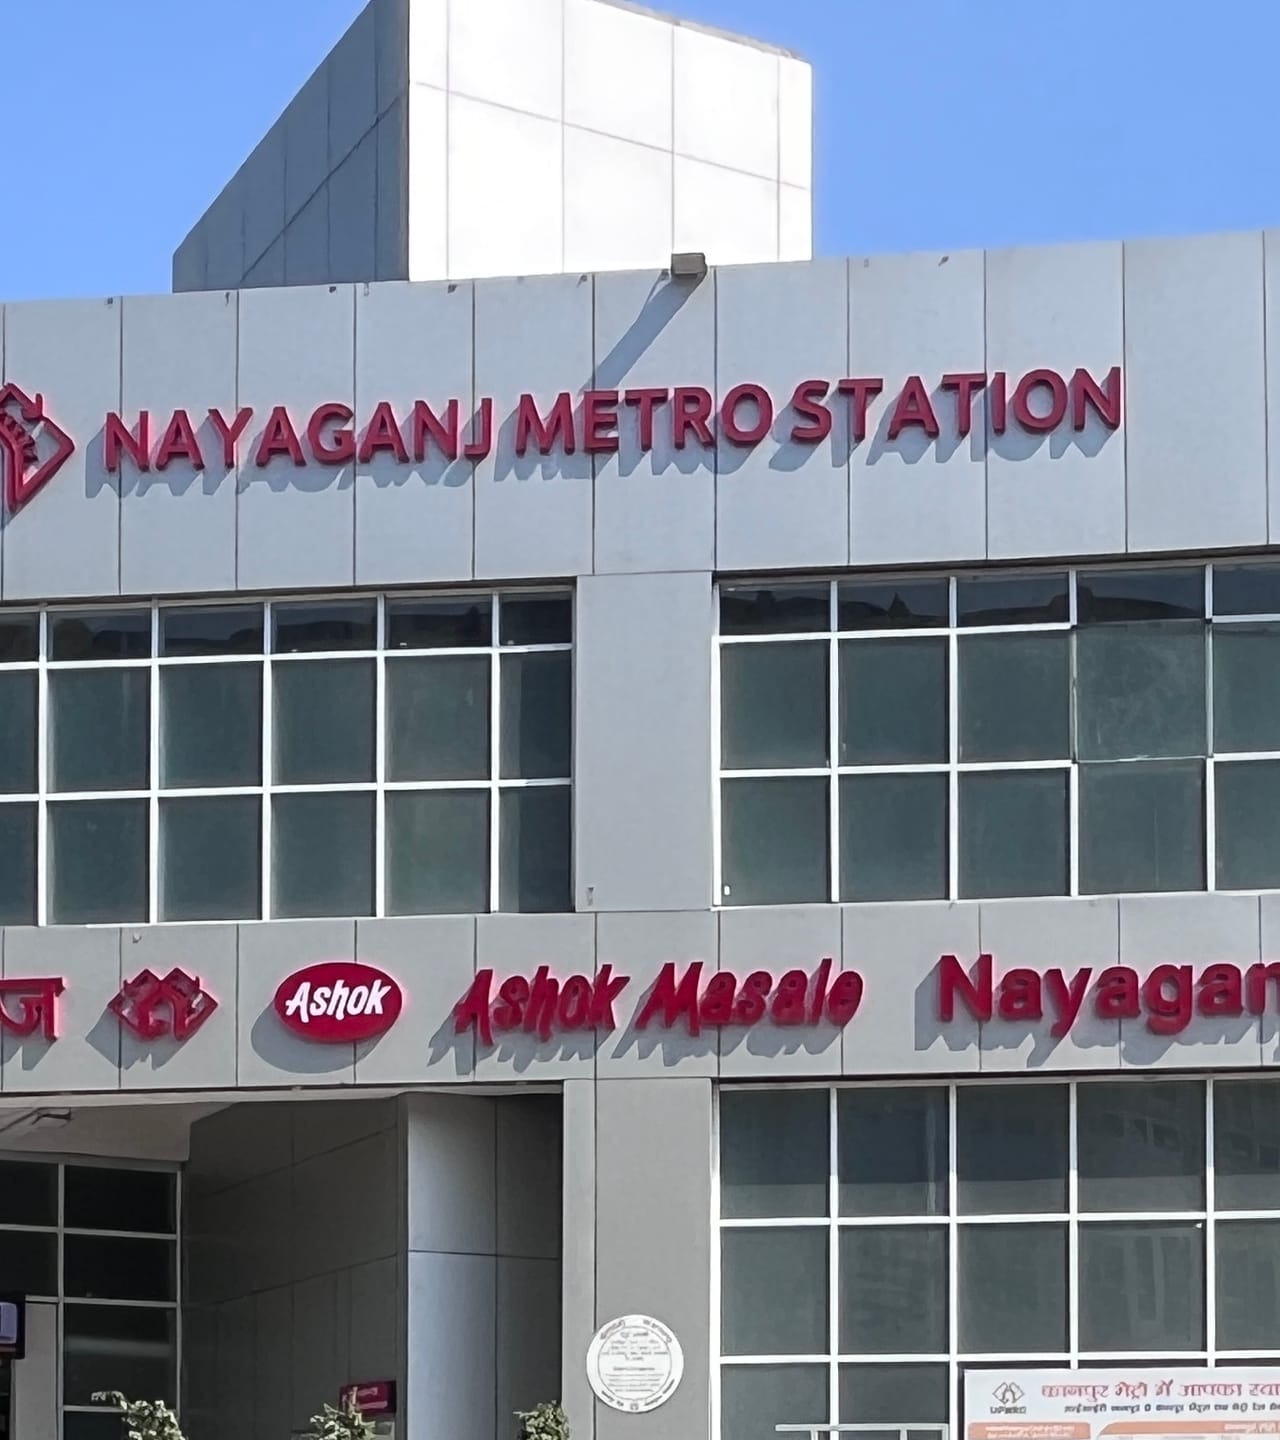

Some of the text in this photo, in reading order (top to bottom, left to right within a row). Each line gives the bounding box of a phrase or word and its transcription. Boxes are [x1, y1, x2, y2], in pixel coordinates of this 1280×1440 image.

[103, 365, 1123, 475] NAYAGANJ METRO STATION
[283, 978, 390, 1021] Ashok
[451, 963, 631, 1048] Ashok
